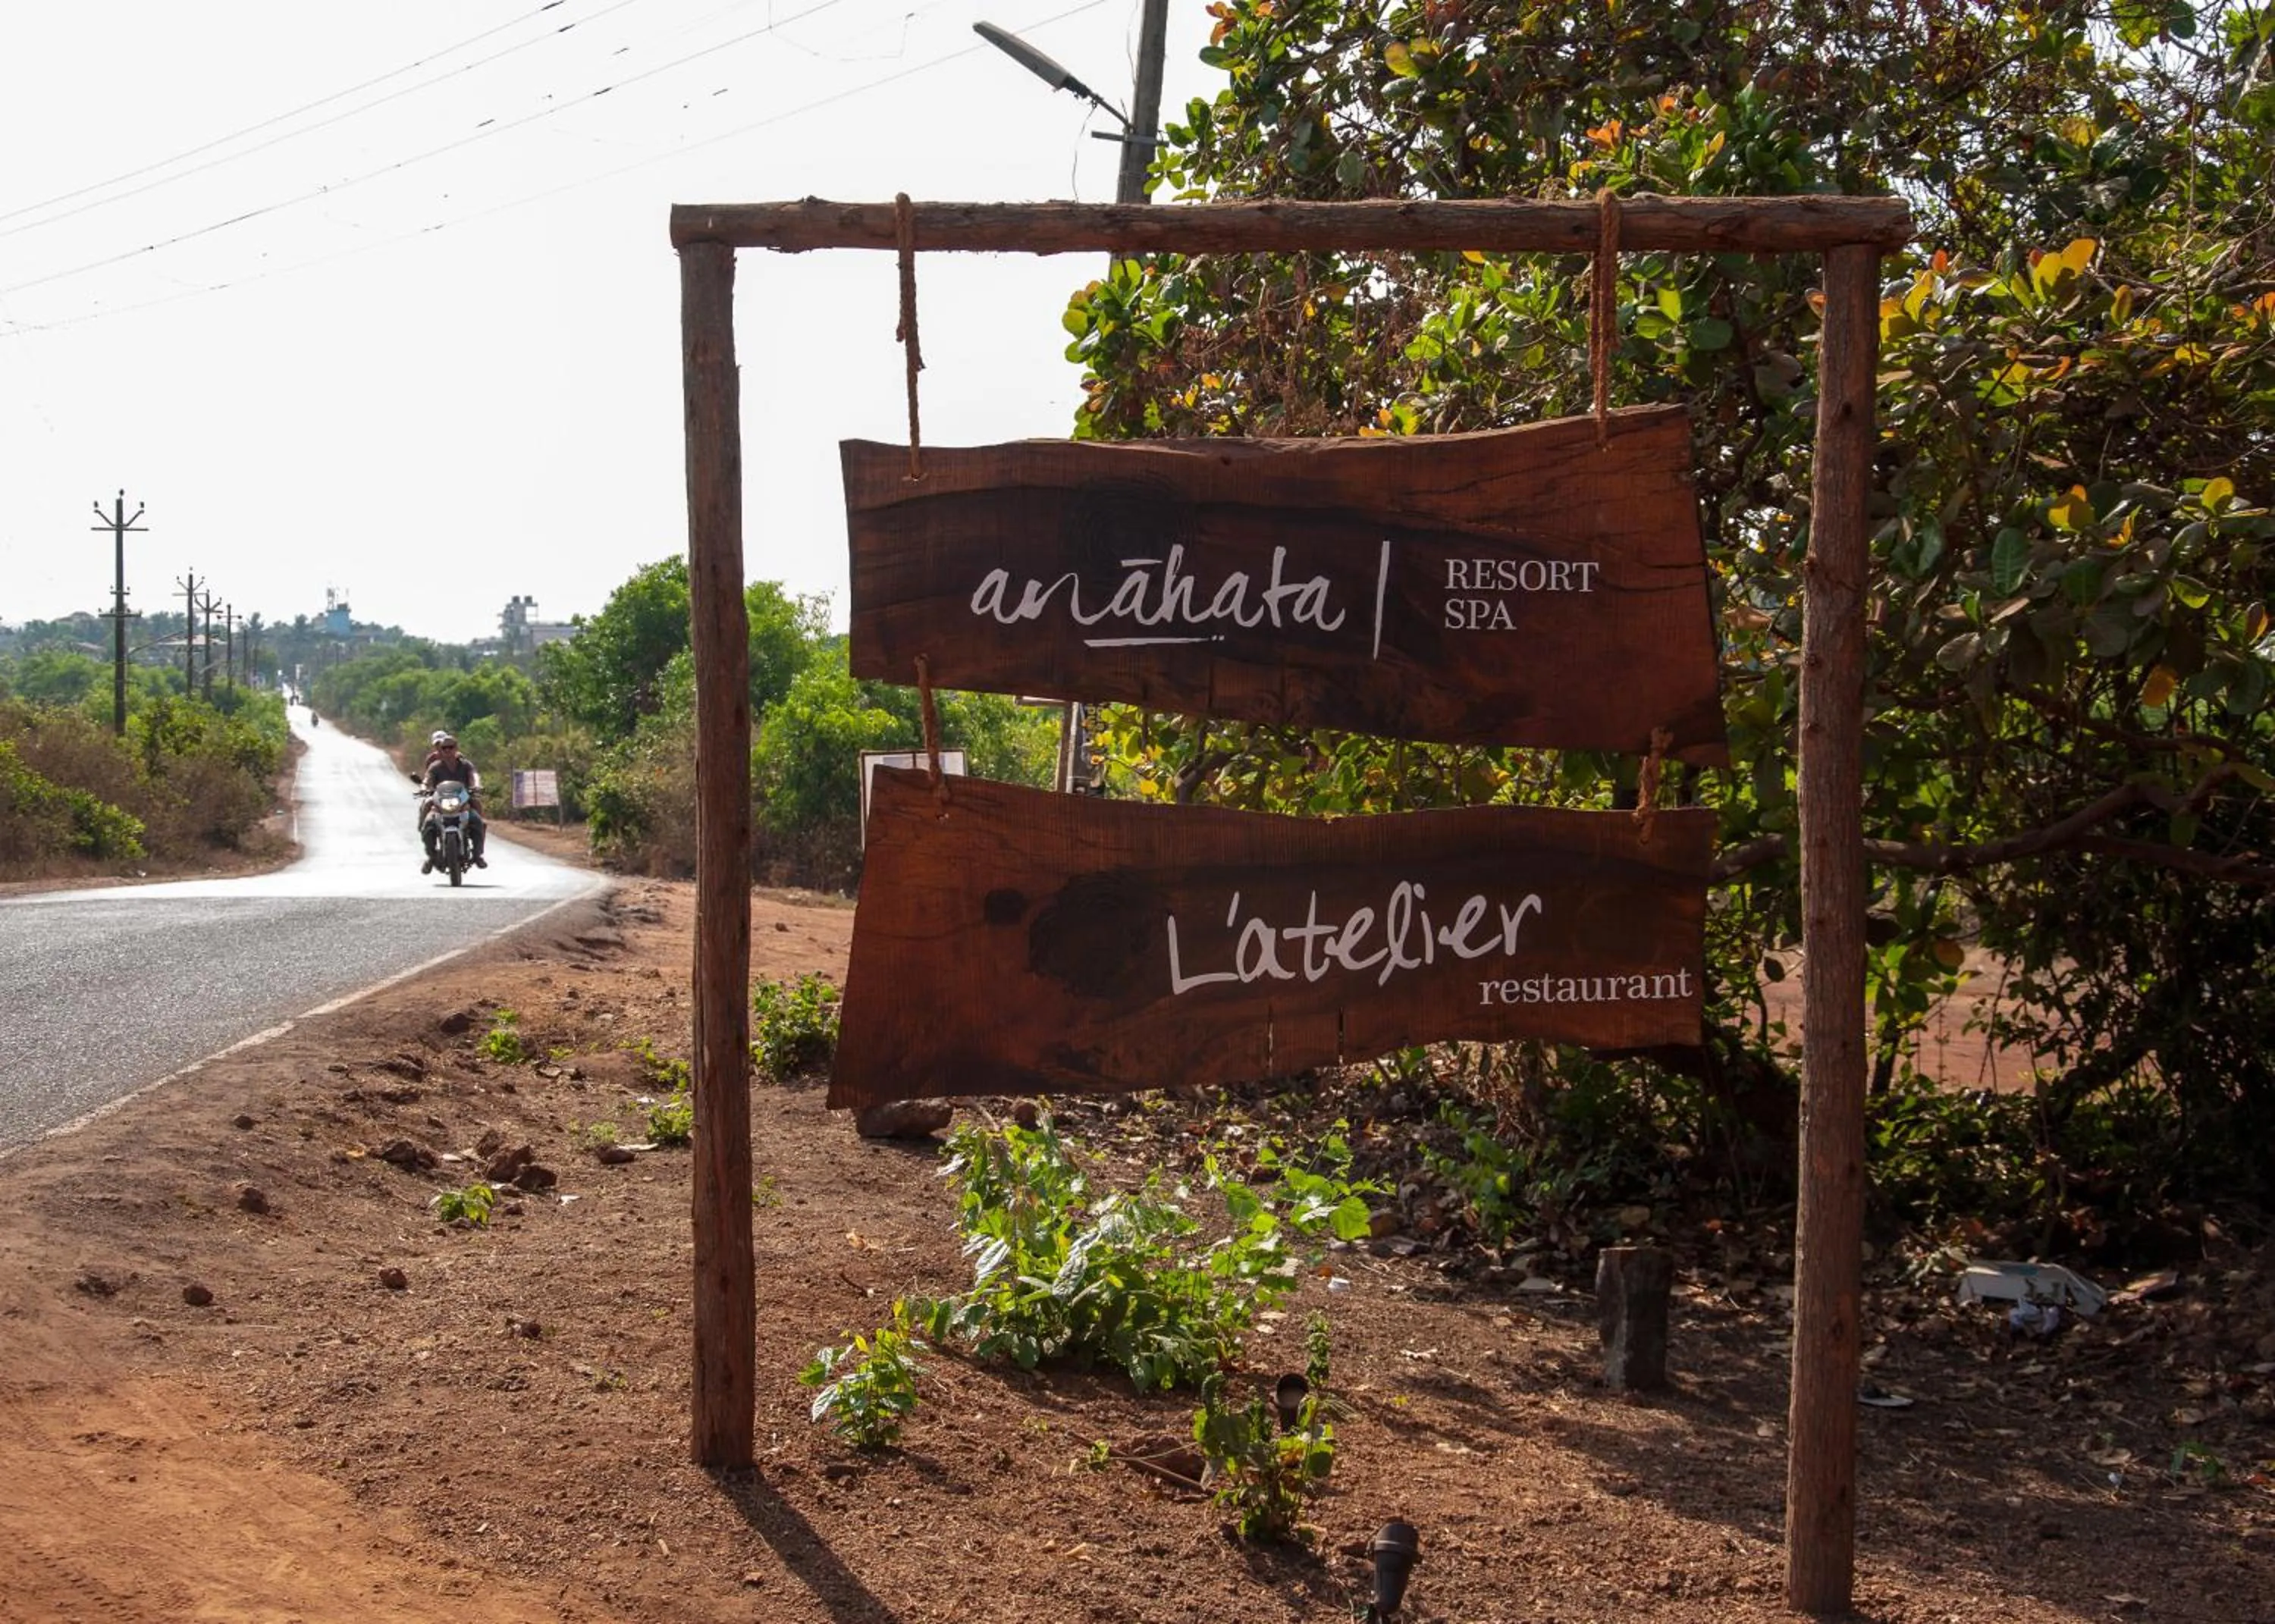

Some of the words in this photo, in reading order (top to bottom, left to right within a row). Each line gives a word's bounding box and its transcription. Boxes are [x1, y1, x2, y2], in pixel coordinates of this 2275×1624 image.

[970, 544, 1345, 632] anāhata
[1444, 558, 1599, 592] RESORT
[1444, 597, 1517, 630] SPA
[1167, 880, 1542, 995] L'atelier
[1479, 967, 1693, 1005] restaurant
